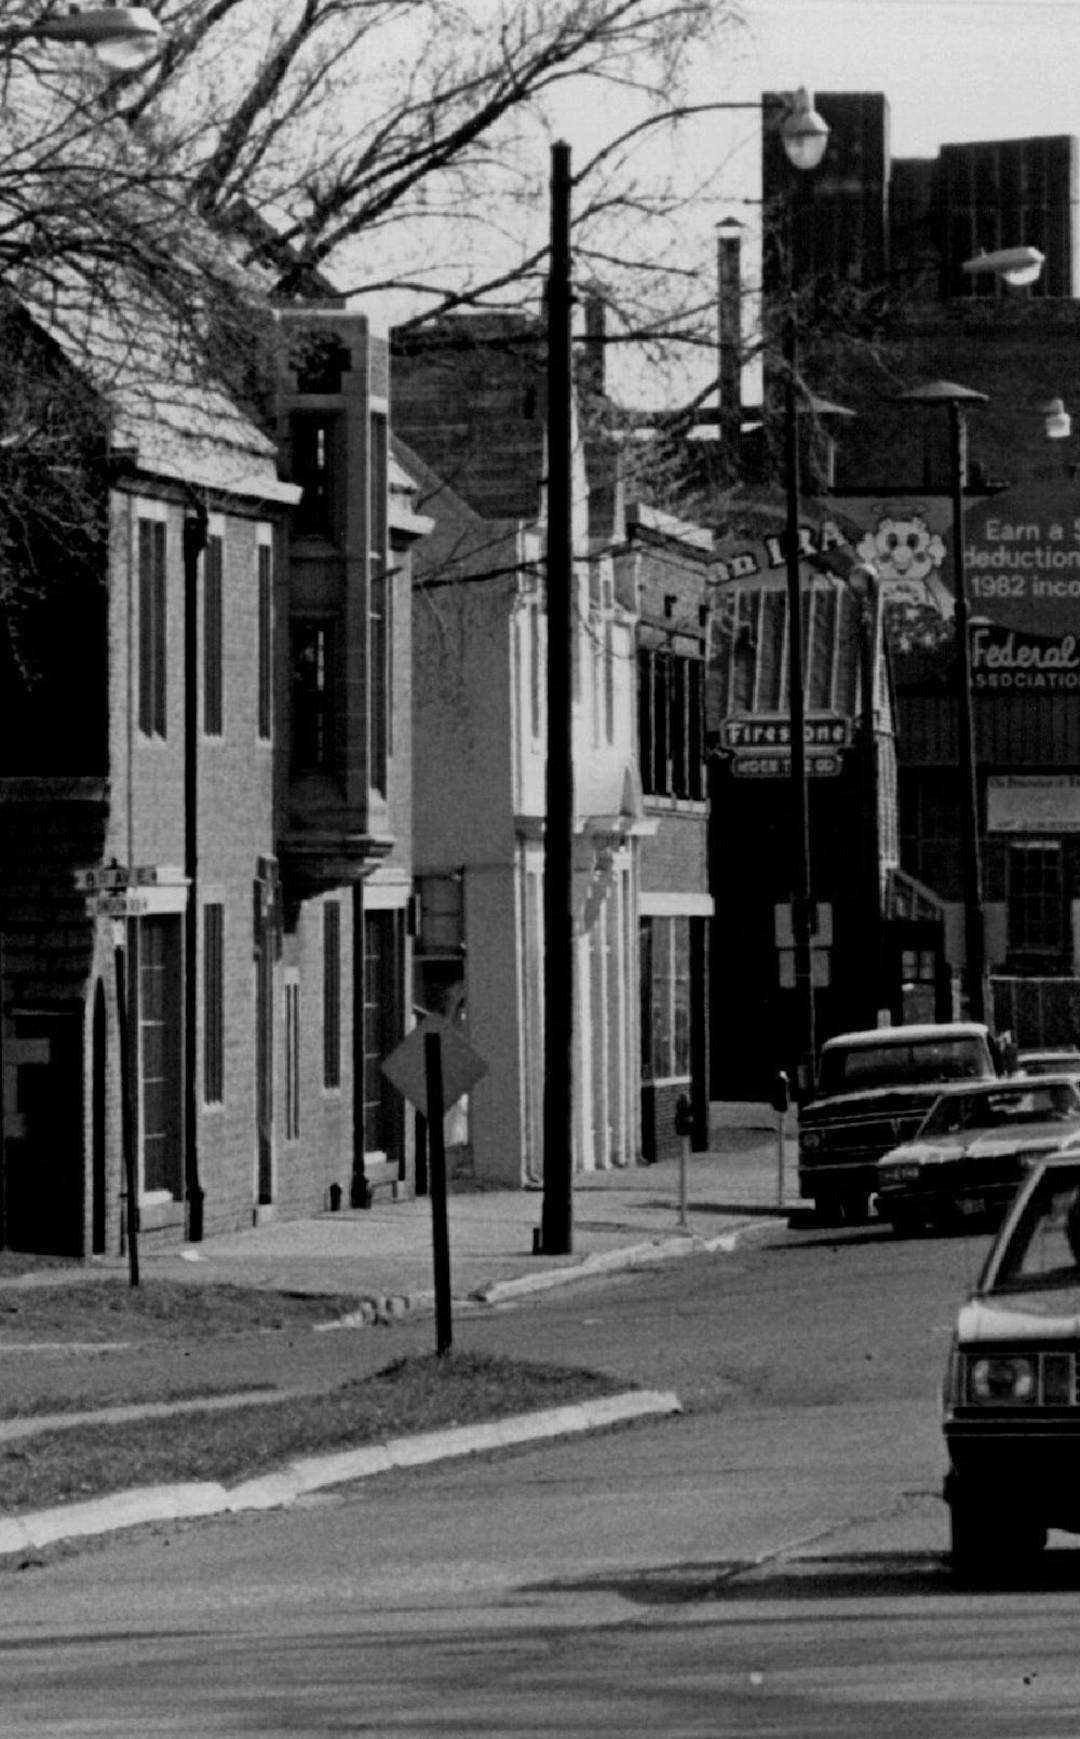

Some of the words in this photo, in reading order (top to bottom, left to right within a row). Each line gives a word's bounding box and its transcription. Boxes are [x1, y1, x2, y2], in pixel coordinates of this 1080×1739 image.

[986, 519, 1040, 541] Earn
[1049, 523, 1064, 541] a
[971, 575, 1025, 597] 1982
[972, 627, 1080, 668] Federal
[727, 723, 844, 744] Firesone
